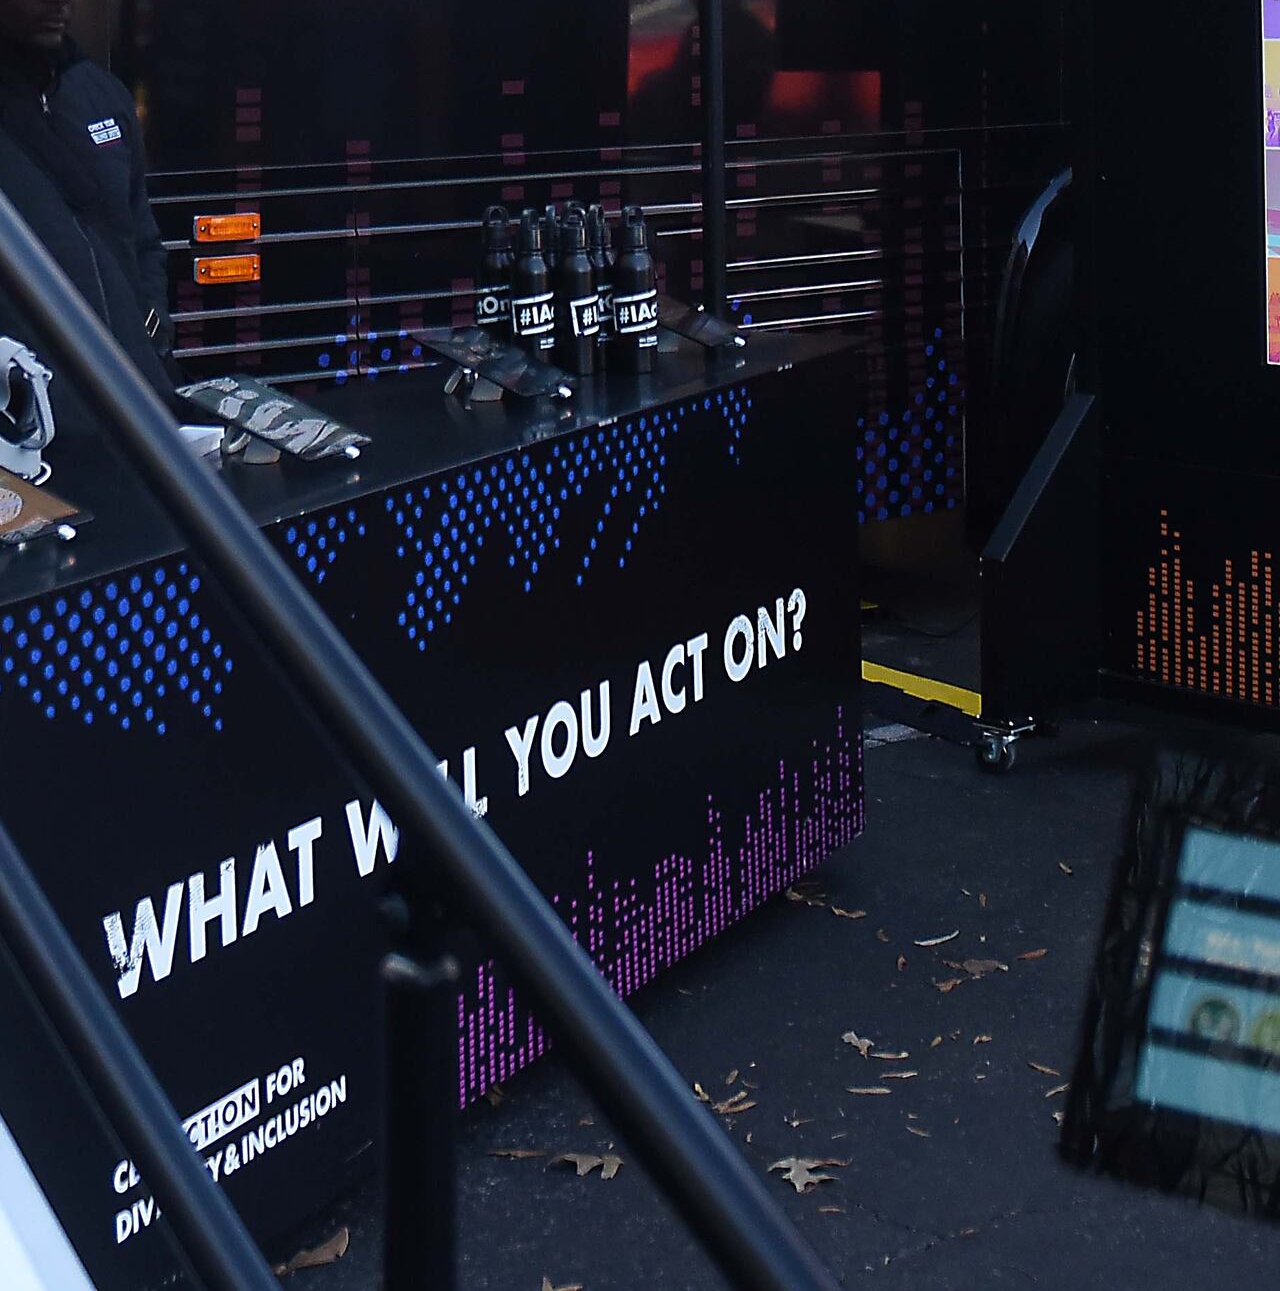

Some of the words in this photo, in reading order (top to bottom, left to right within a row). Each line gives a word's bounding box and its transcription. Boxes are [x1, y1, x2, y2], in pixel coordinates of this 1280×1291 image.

[101, 816, 323, 999] WHAT
[345, 746, 488, 878] WL
[505, 680, 611, 797] YOU
[629, 632, 709, 737] ACT
[723, 587, 808, 683] ON?
[242, 1074, 347, 1165] INCLUSION
[266, 1057, 306, 1104] FOR
